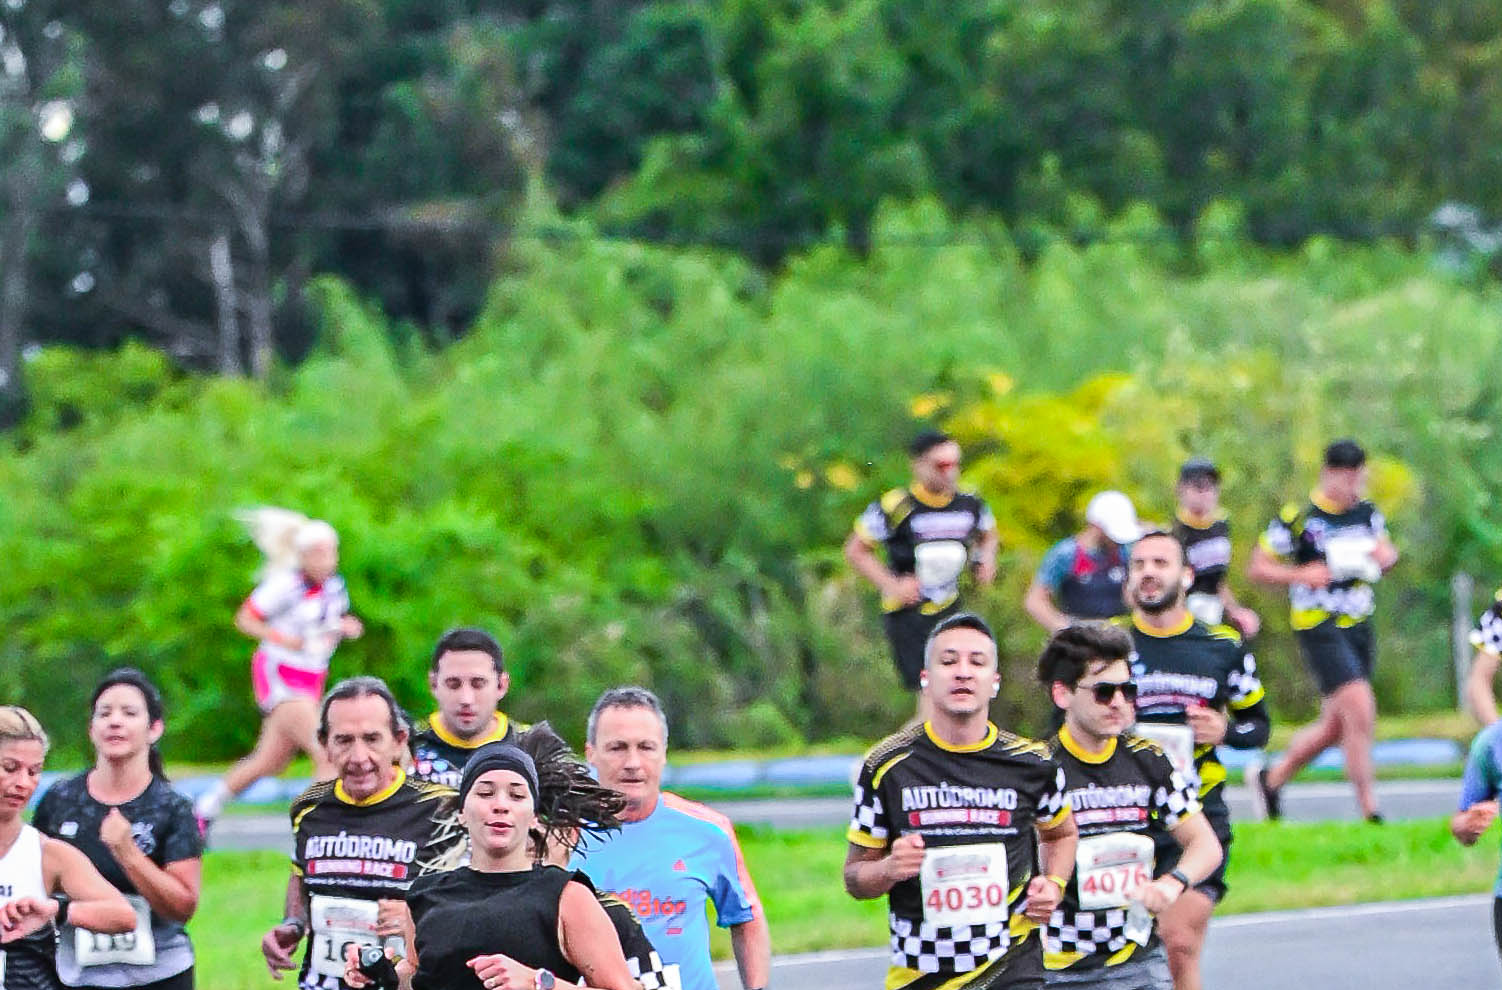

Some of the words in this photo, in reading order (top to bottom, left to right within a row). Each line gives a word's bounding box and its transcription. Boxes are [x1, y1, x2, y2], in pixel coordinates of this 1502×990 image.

[902, 781, 1018, 811] AUTÓDROMO
[304, 831, 417, 863] AUTÓDROMO
[927, 884, 1003, 912] 4030
